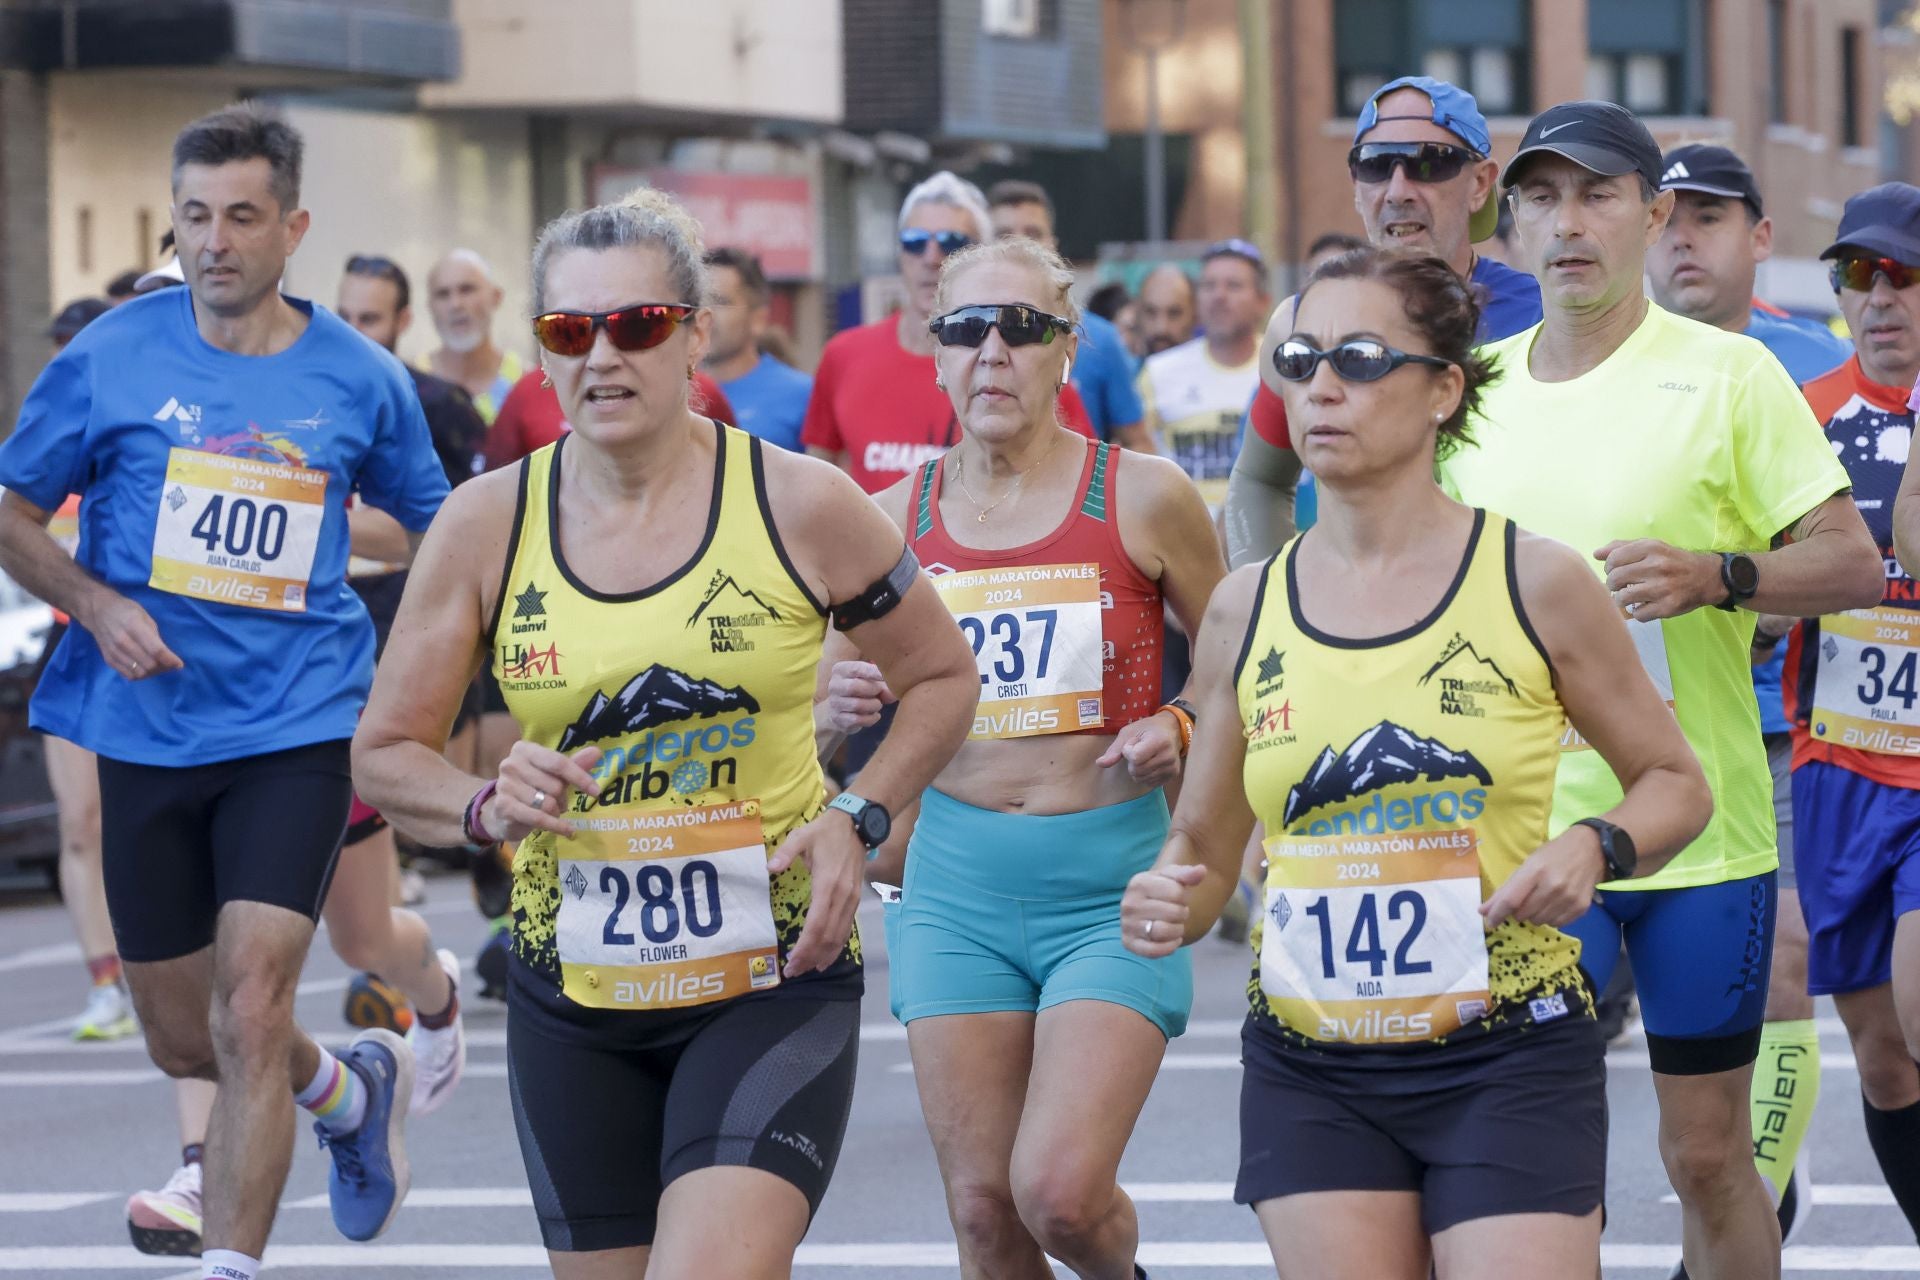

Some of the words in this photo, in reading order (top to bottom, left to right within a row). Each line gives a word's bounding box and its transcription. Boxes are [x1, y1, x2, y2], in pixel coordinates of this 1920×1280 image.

[231, 476, 266, 492] 2024
[191, 494, 288, 561] 400
[206, 553, 228, 567] JUAN
[229, 557, 262, 573] CARLOS
[952, 575, 986, 589] MEDIA
[989, 568, 1052, 584] MARATÓN
[1054, 564, 1096, 580] AVILÉS
[984, 589, 1023, 605] 2024
[511, 619, 547, 634] luanvi
[1875, 626, 1910, 641] 2024
[958, 609, 1058, 685] 237
[1857, 646, 1919, 710] 34
[997, 683, 1029, 698] CRISTI
[972, 706, 1060, 735] avilés
[1871, 707, 1898, 721] PAULA
[590, 817, 629, 832] MEDIA
[633, 808, 707, 831] MARATÓN
[1289, 788, 1488, 837] enderos
[627, 835, 675, 853] 2024
[1299, 843, 1338, 857] MEDIA
[1343, 837, 1415, 855] MARATÓN
[1417, 834, 1471, 851] AVILÉS
[1336, 863, 1381, 881] 2024
[600, 860, 723, 946] 280
[1306, 890, 1433, 979] 142
[640, 944, 688, 962] FLOWER
[613, 970, 726, 1003] avilés
[1356, 982, 1384, 997] AIDA
[1318, 1009, 1434, 1040] avilés
